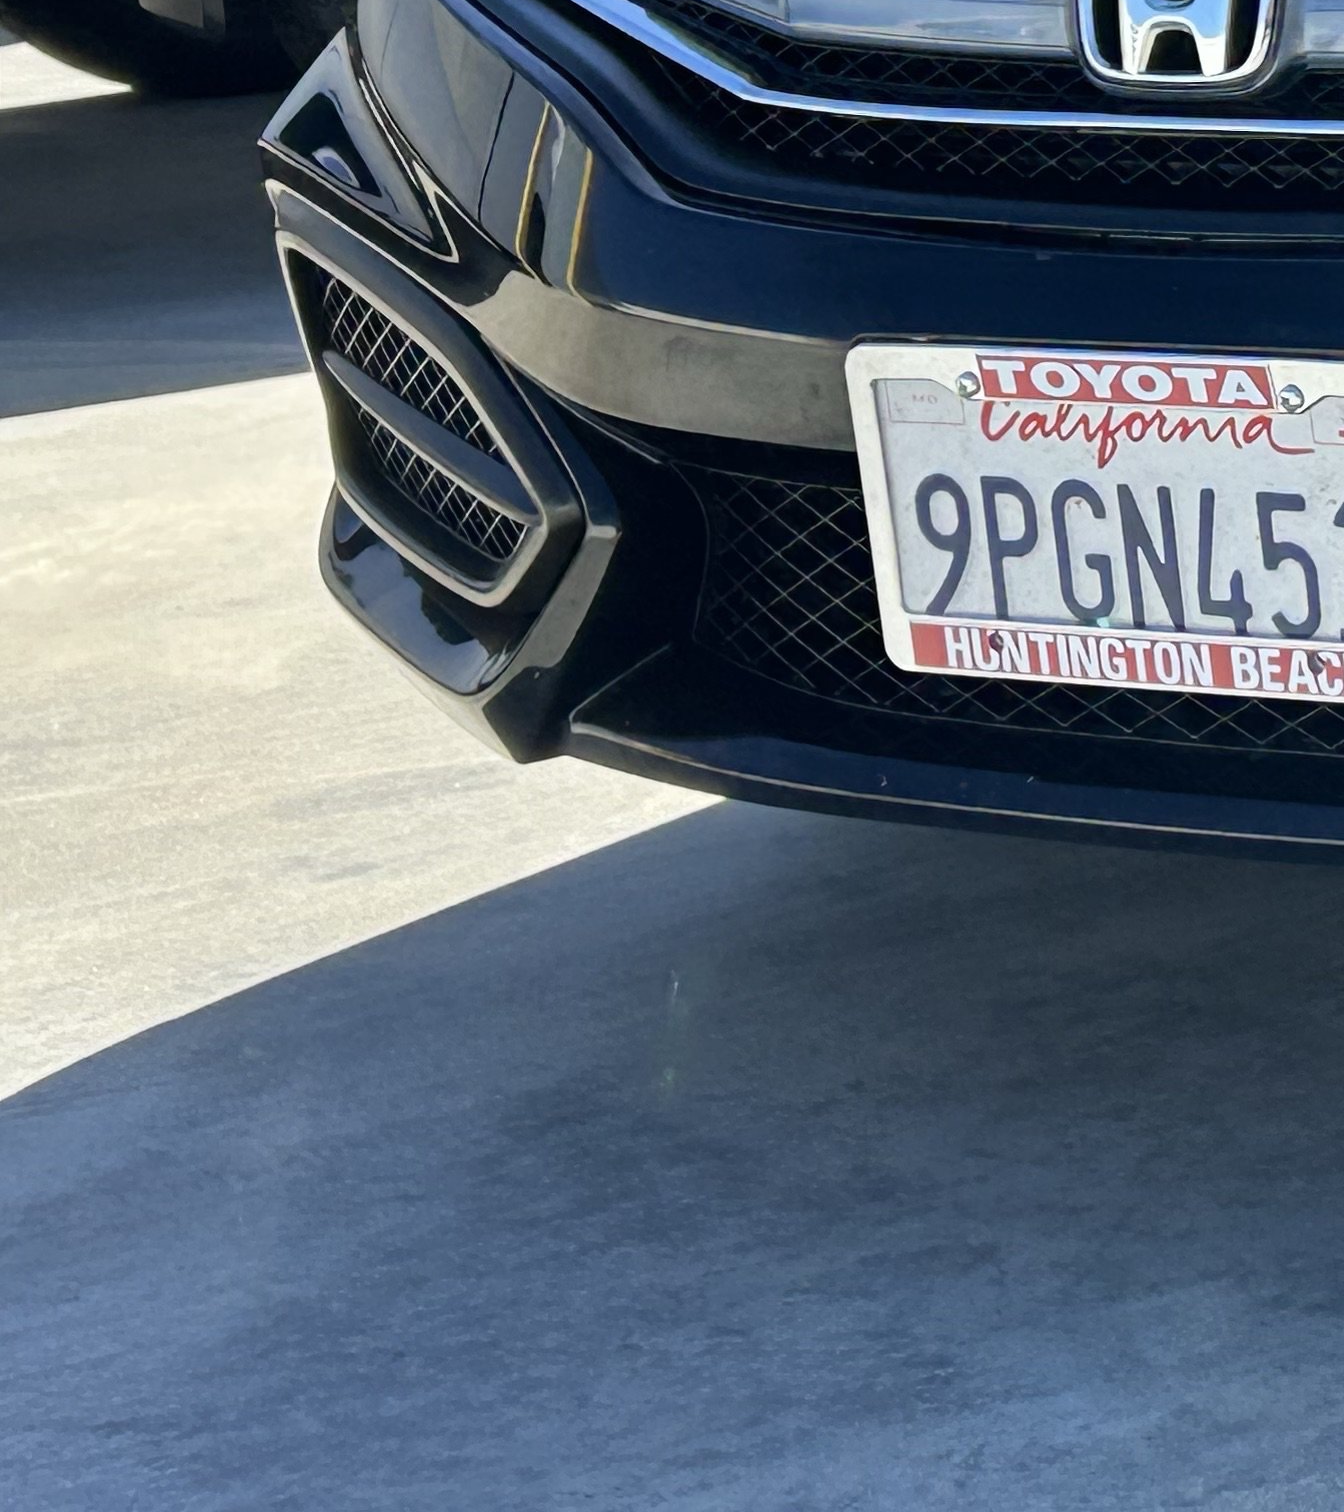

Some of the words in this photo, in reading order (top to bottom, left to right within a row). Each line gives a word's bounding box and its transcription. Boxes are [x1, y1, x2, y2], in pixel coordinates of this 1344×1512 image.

[981, 359, 1266, 405] TOYOTA
[980, 400, 1315, 469] California
[944, 627, 1213, 687] HUNTINGTON
